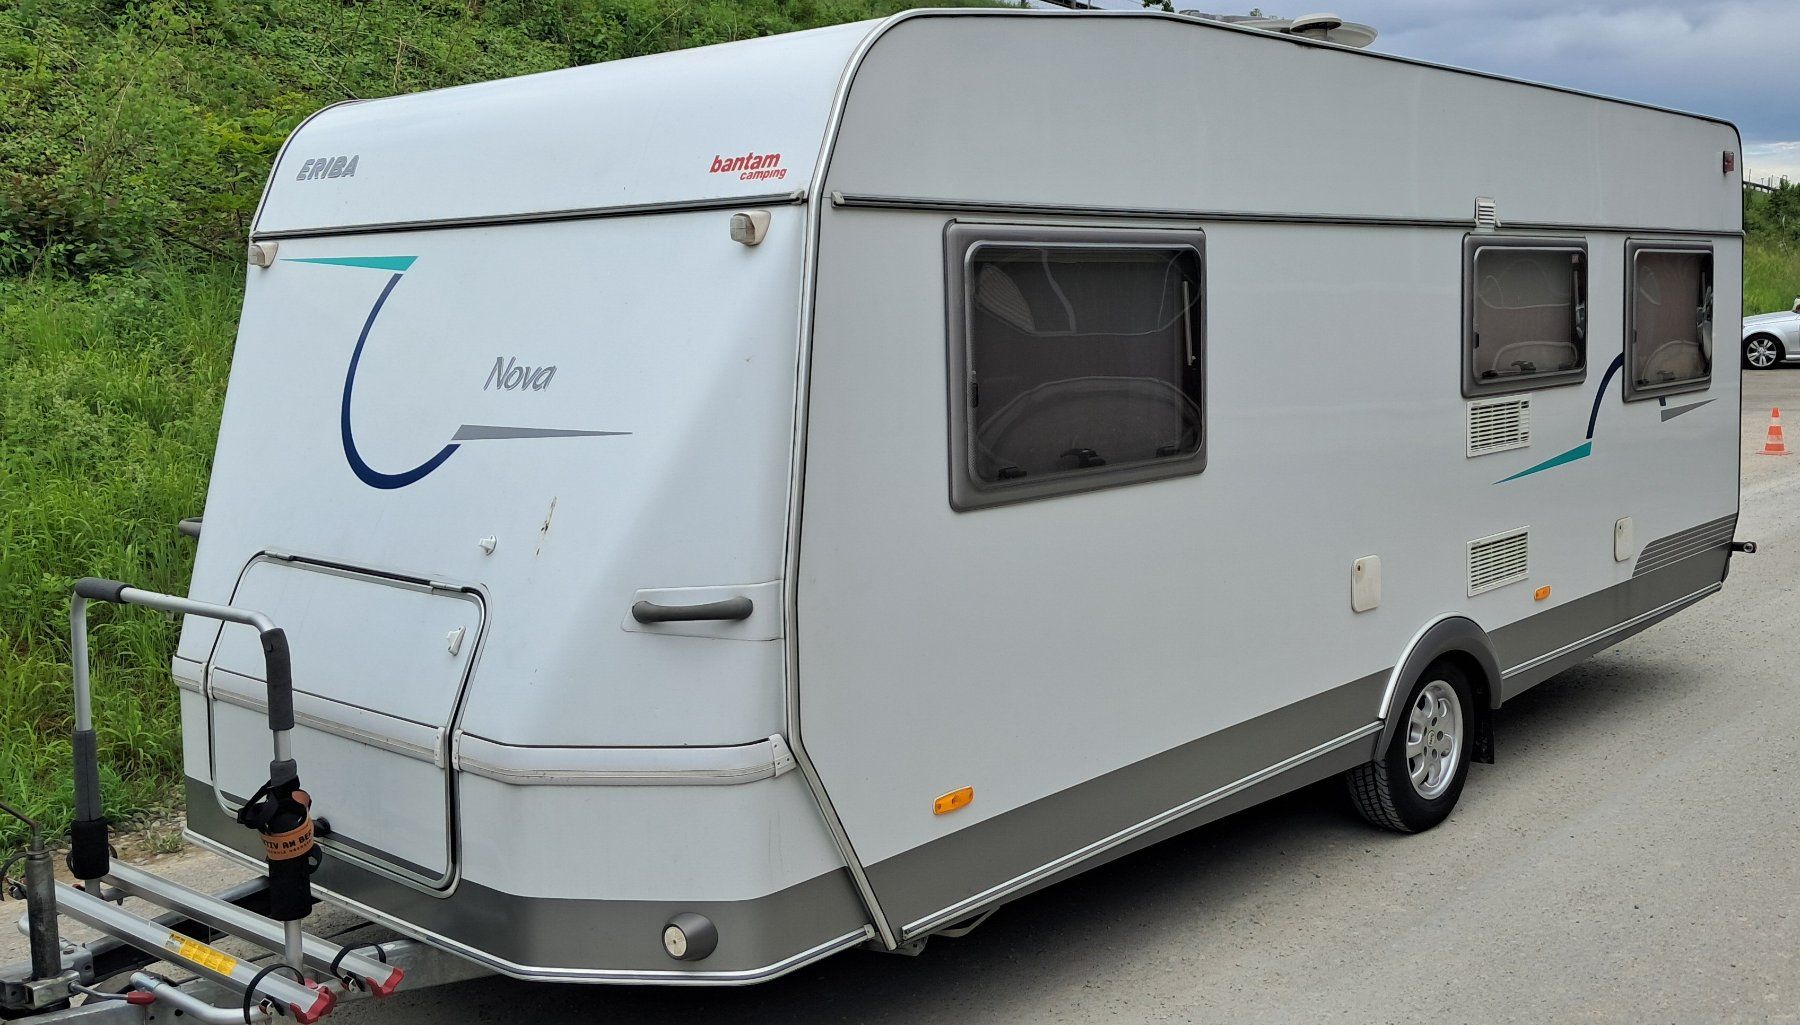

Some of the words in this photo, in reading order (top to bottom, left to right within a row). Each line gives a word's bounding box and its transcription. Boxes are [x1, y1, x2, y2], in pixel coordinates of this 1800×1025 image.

[296, 154, 360, 181] ERIBA
[709, 152, 781, 173] bantam
[740, 168, 787, 181] camping
[483, 356, 557, 392] Nova
